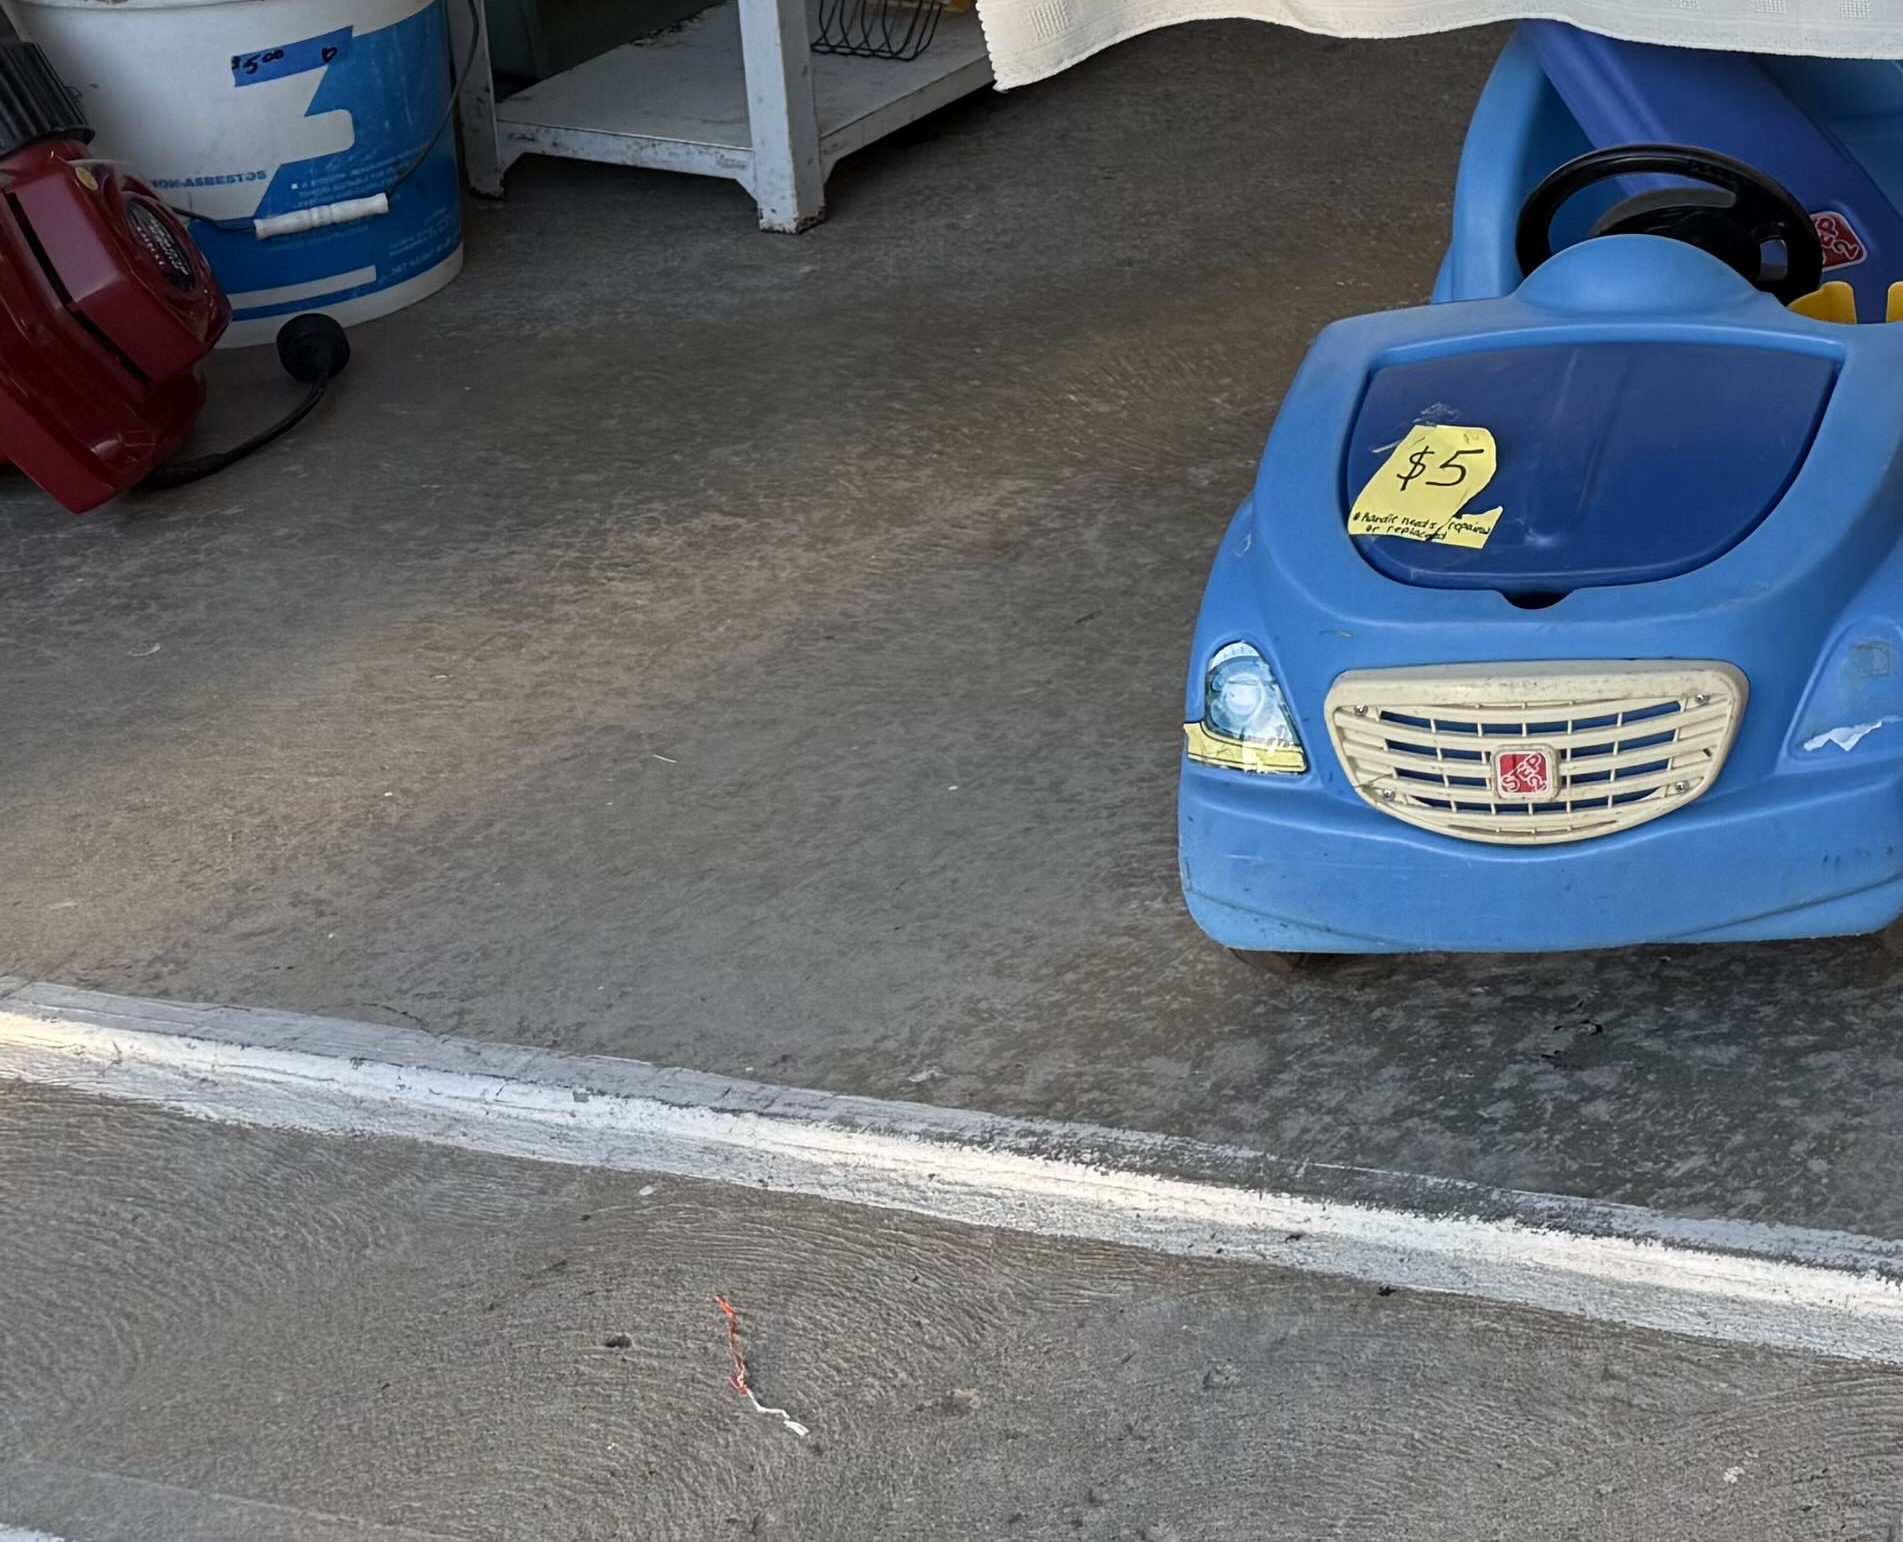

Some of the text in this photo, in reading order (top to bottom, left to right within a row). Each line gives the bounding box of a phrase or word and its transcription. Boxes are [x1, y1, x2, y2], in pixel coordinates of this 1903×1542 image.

[1396, 445, 1485, 491] $5
[1402, 516, 1437, 530] needs
[1366, 524, 1447, 541] or replaced
